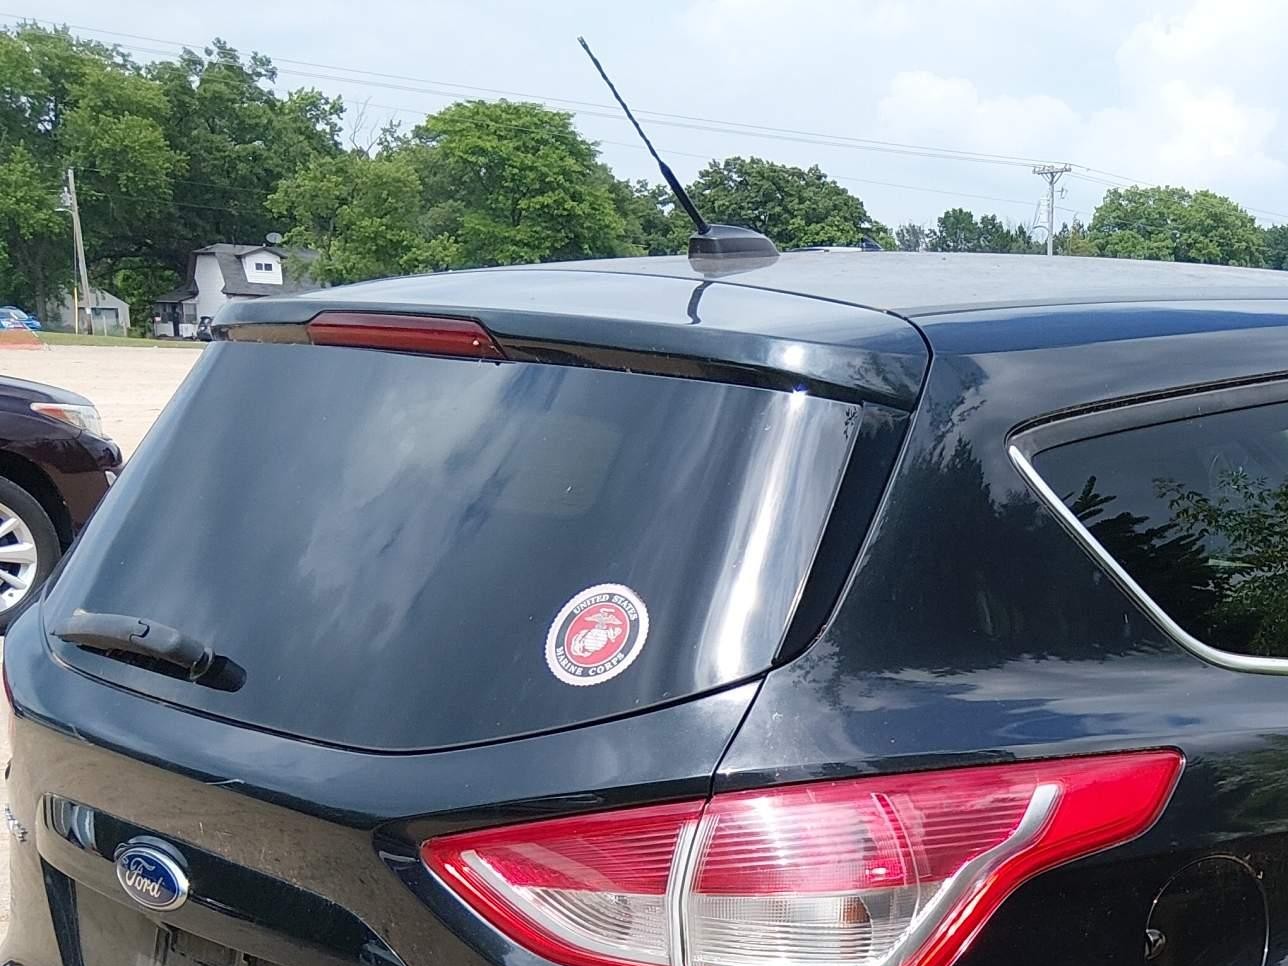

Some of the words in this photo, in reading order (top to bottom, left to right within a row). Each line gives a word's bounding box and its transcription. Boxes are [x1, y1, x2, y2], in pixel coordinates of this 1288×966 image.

[573, 594, 610, 614] UNITED
[611, 594, 638, 621] STATES
[556, 646, 584, 675] MARINE
[588, 652, 625, 676] CORPS
[125, 857, 163, 898] Ford
